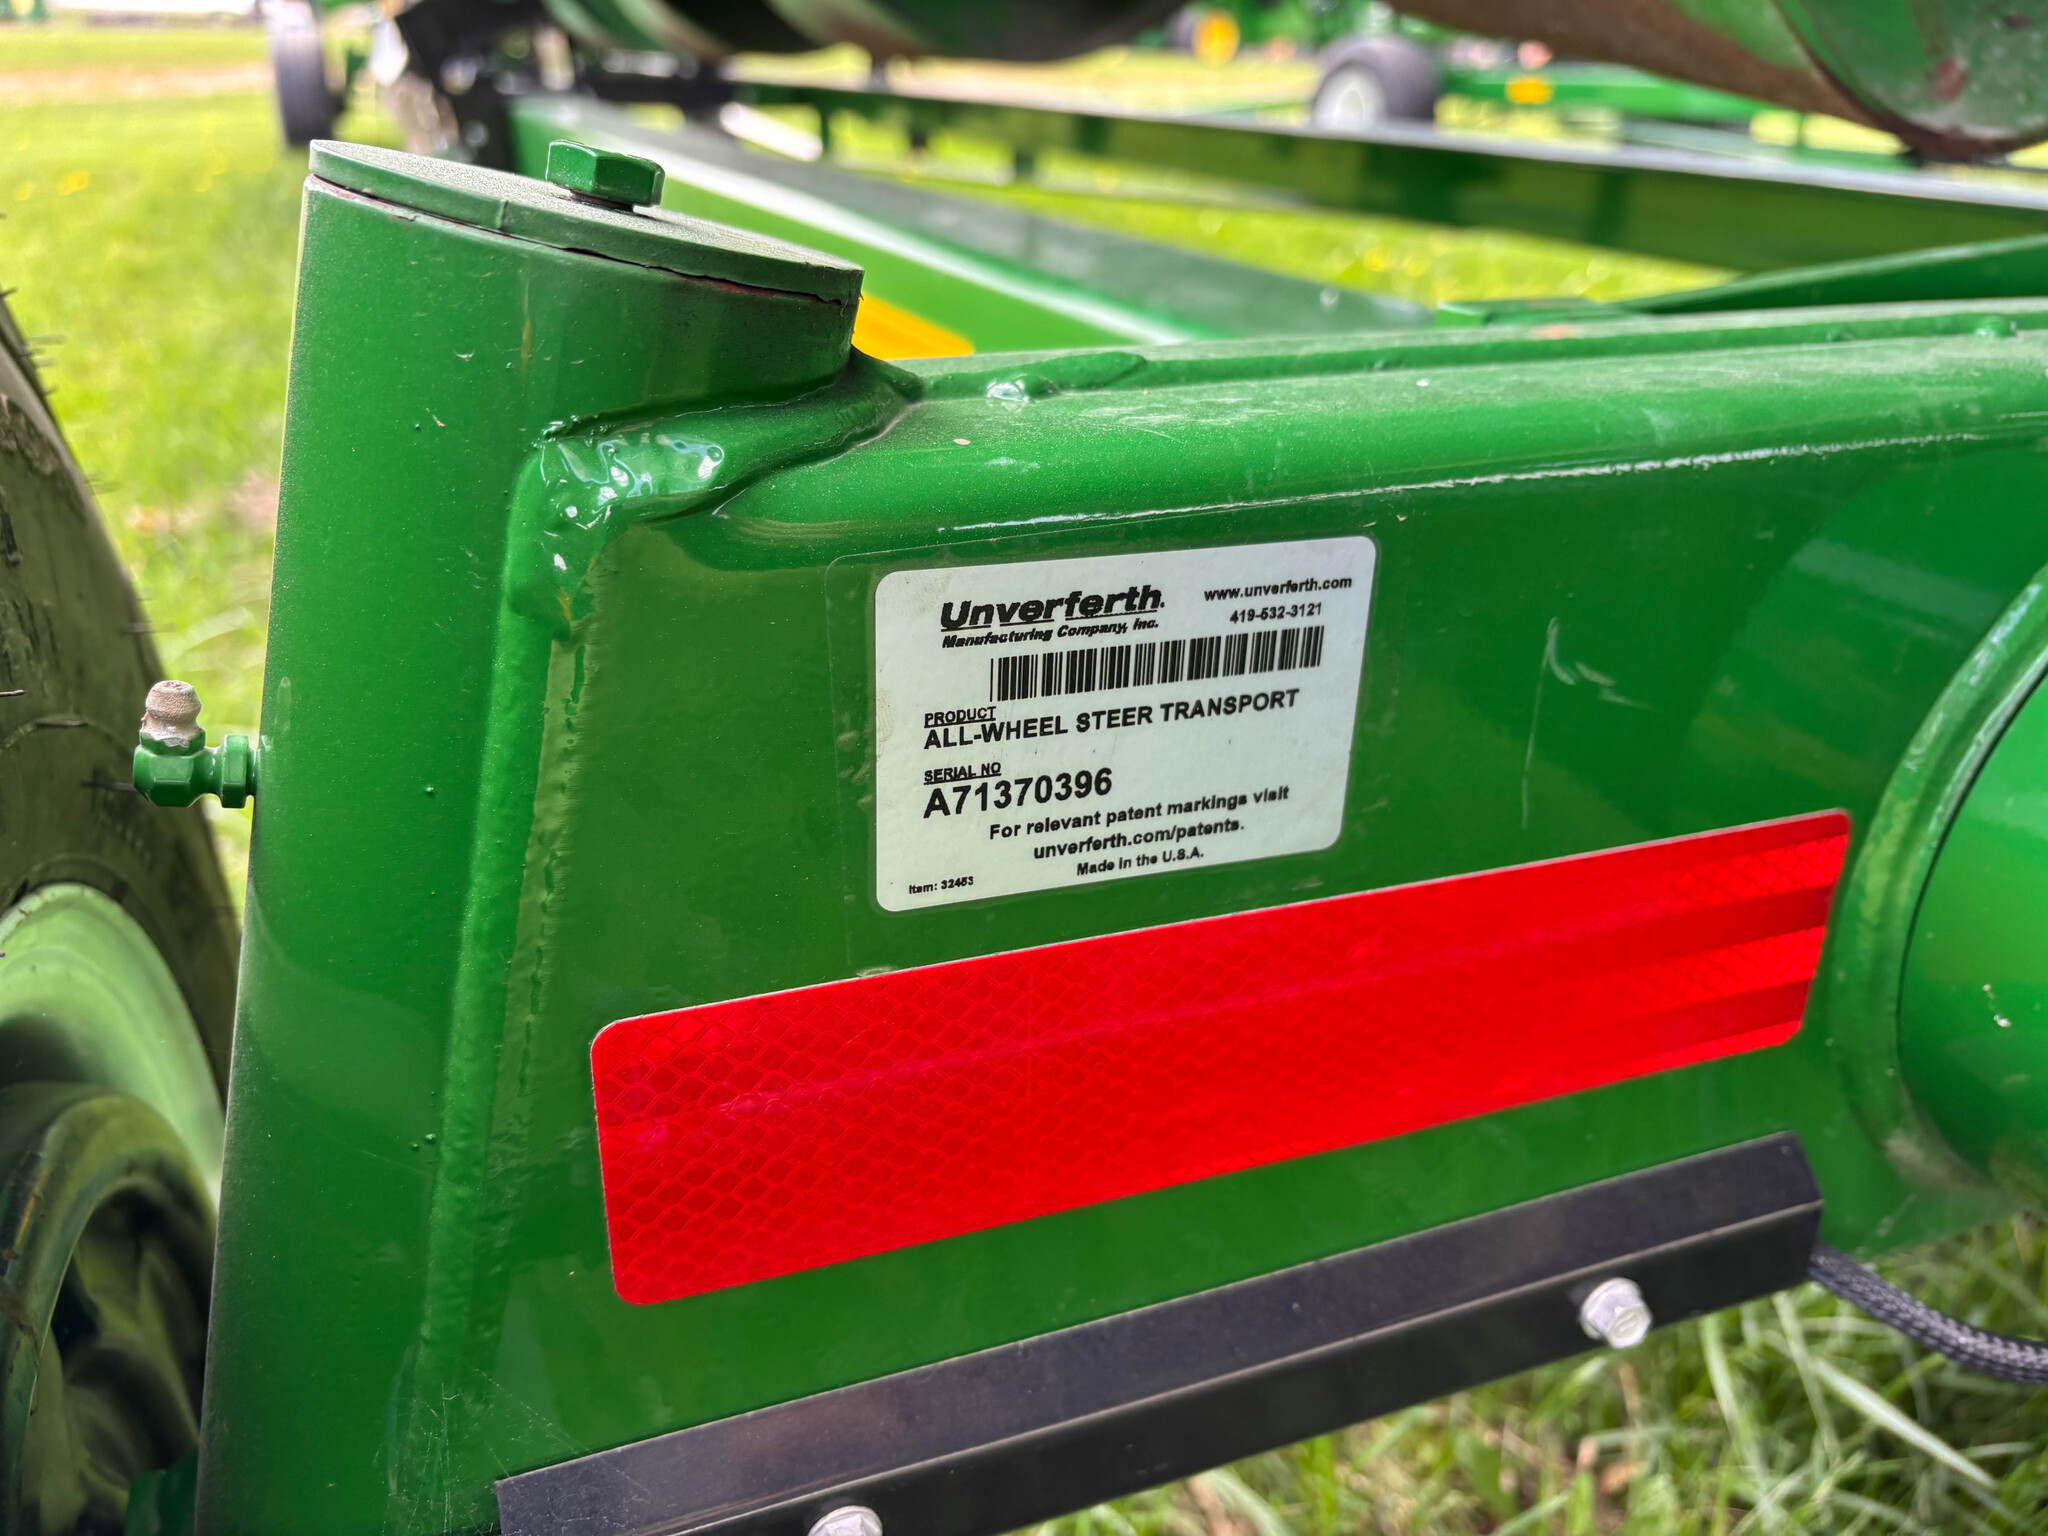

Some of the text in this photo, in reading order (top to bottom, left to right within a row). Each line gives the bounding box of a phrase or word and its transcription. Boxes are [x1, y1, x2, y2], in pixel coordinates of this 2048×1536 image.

[1204, 577, 1353, 601] www.unverferth.com
[1229, 602, 1322, 624] 419-532-3121
[942, 628, 1054, 648] Manufacturing
[1057, 619, 1129, 638] Company,
[923, 688, 1300, 749] ALL-WHEEL STEER TRANSPORT
[924, 706, 997, 728] PRODUCT
[923, 762, 1002, 784] SERIAL NO
[923, 767, 1114, 819] A71370396
[989, 785, 1290, 840] For relevant patent markings visit
[1033, 818, 1245, 859] unverferth.com/patents.
[1076, 845, 1204, 876] Made in the U.S.A.
[908, 882, 938, 895] Item:
